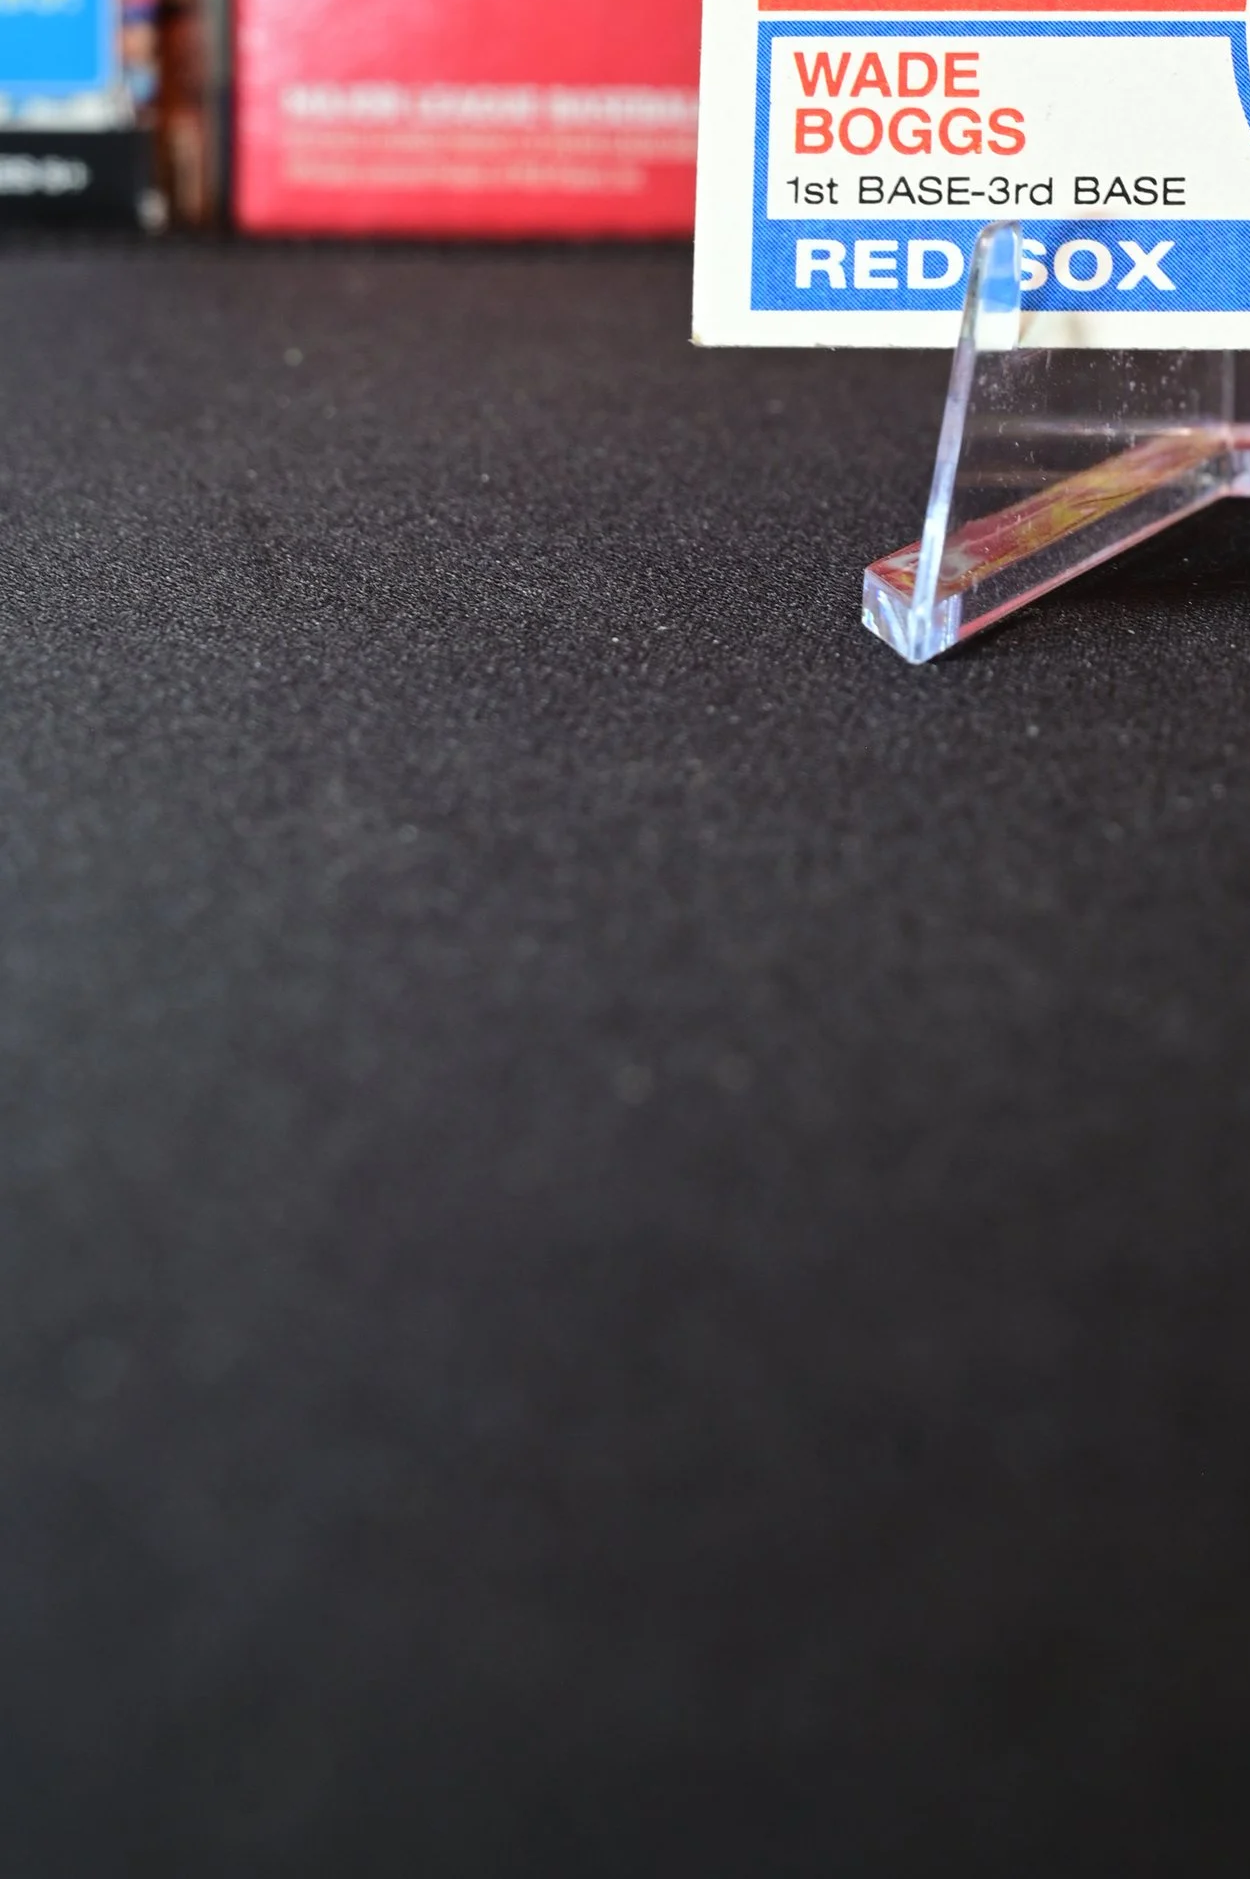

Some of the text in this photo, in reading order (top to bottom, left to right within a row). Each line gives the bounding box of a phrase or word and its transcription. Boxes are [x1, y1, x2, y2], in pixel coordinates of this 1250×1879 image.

[794, 52, 981, 98] WADE
[794, 107, 1027, 156] BOGGS
[786, 175, 1187, 207] 1st BASE-3rd BASE
[794, 238, 1177, 293] RED SOX
